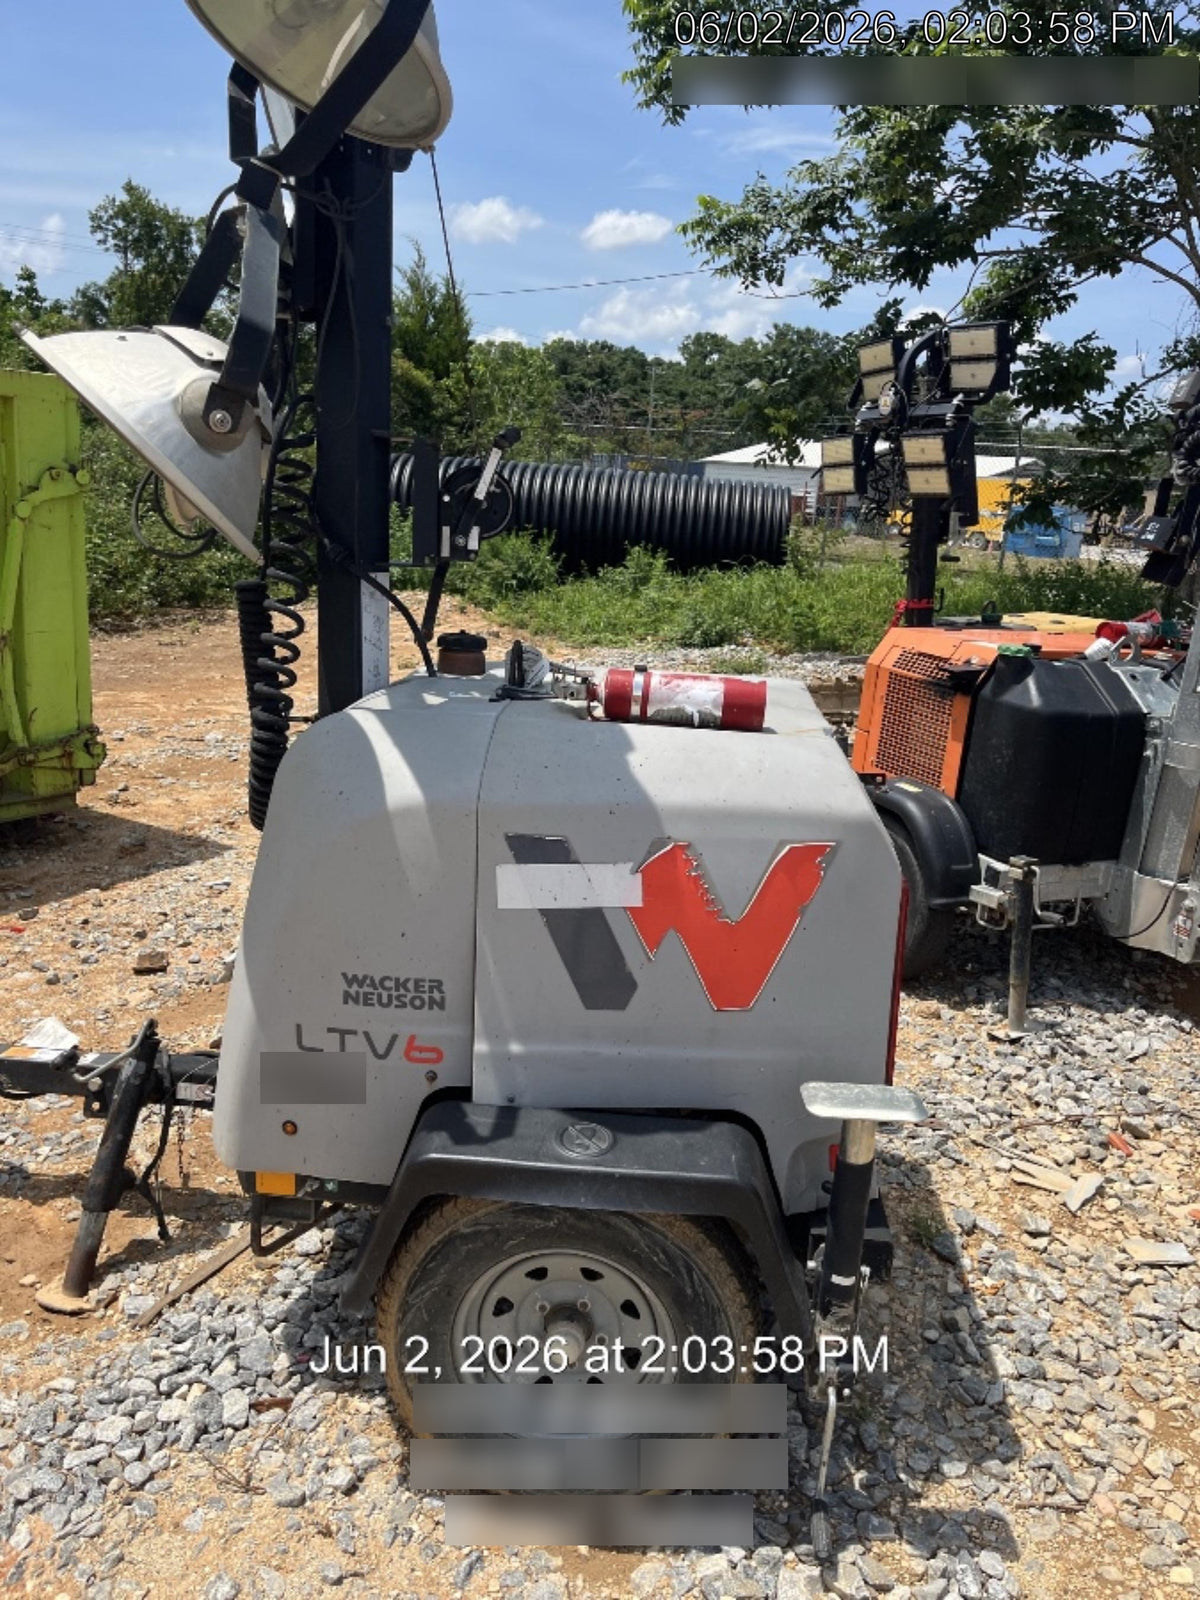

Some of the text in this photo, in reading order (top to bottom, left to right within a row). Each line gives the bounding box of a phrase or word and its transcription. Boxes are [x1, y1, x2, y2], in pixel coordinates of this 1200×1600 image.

[341, 972, 445, 994] WACKER
[342, 990, 446, 1011] NEUSON
[296, 1023, 444, 1065] LTV6
